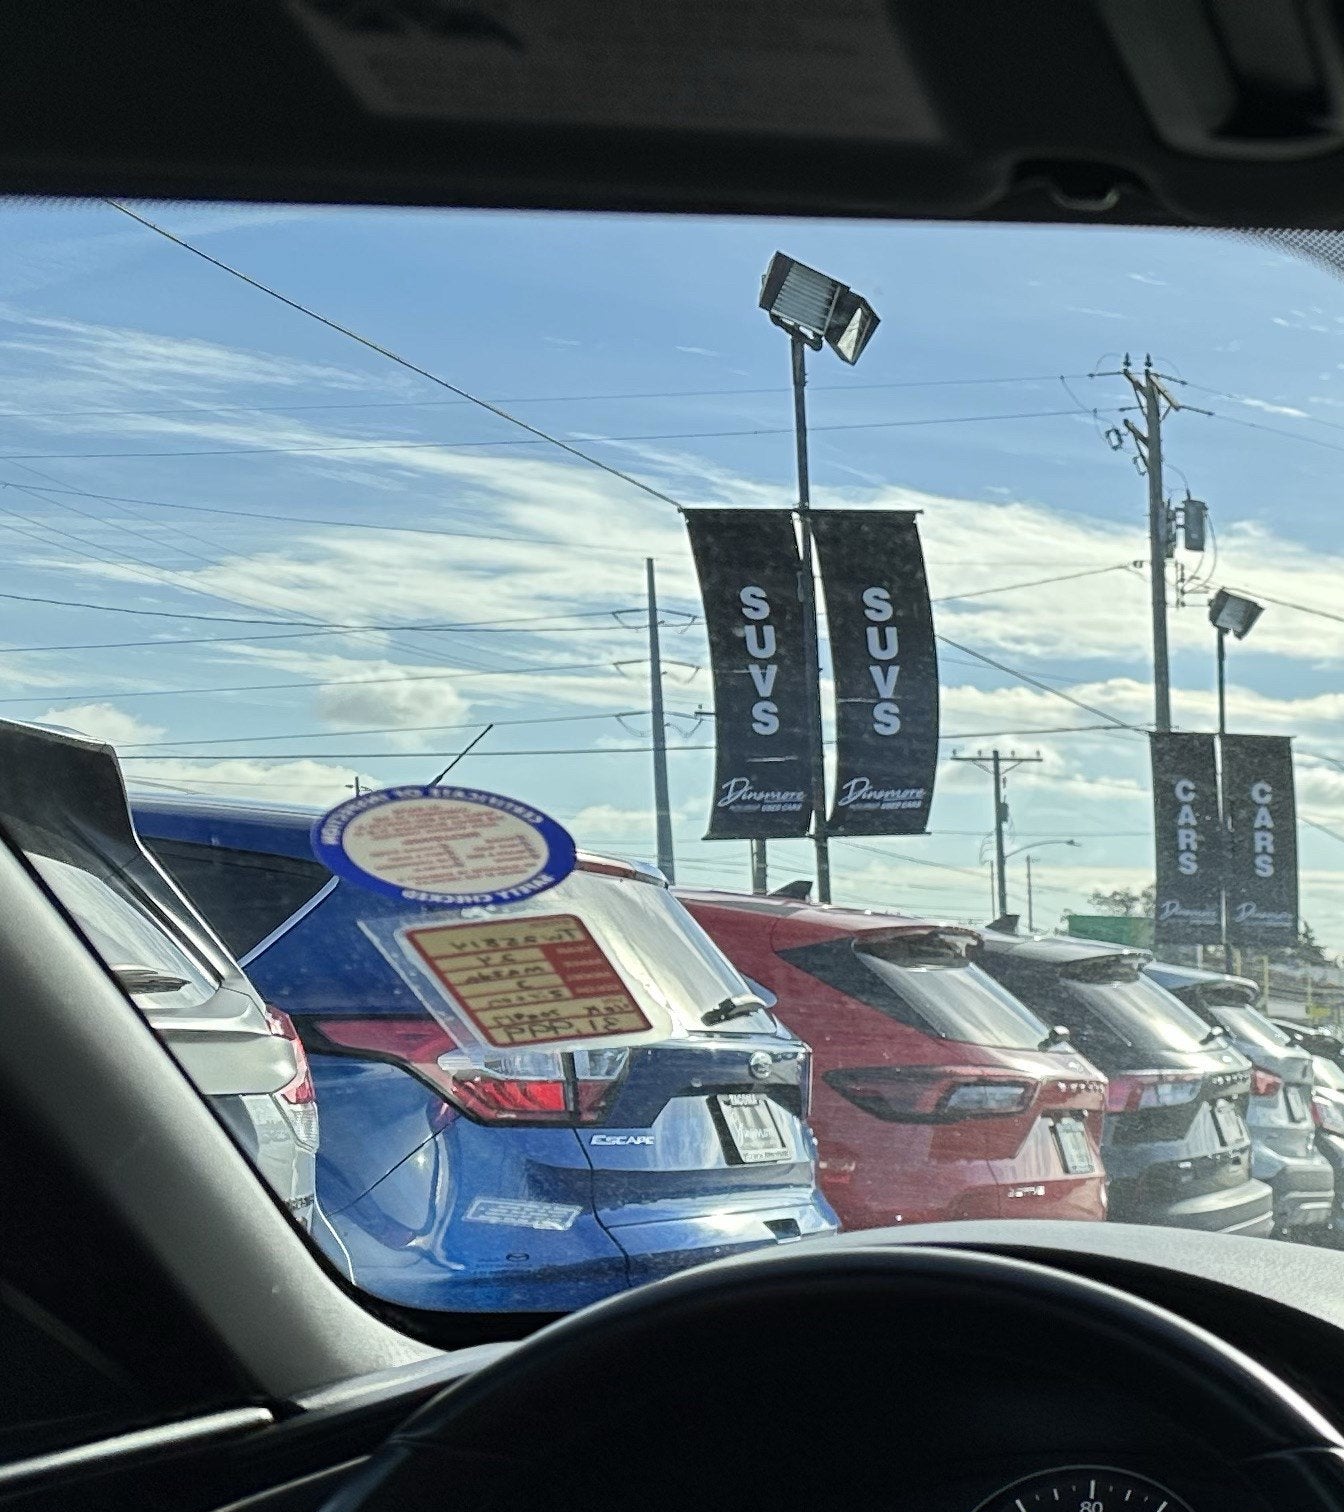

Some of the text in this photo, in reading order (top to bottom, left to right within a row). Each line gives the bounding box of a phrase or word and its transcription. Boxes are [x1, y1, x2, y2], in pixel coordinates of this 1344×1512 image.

[740, 586, 779, 735] SUVS
[863, 587, 900, 735] SUVS
[1174, 778, 1198, 875] CARS
[1251, 780, 1274, 877] CARS
